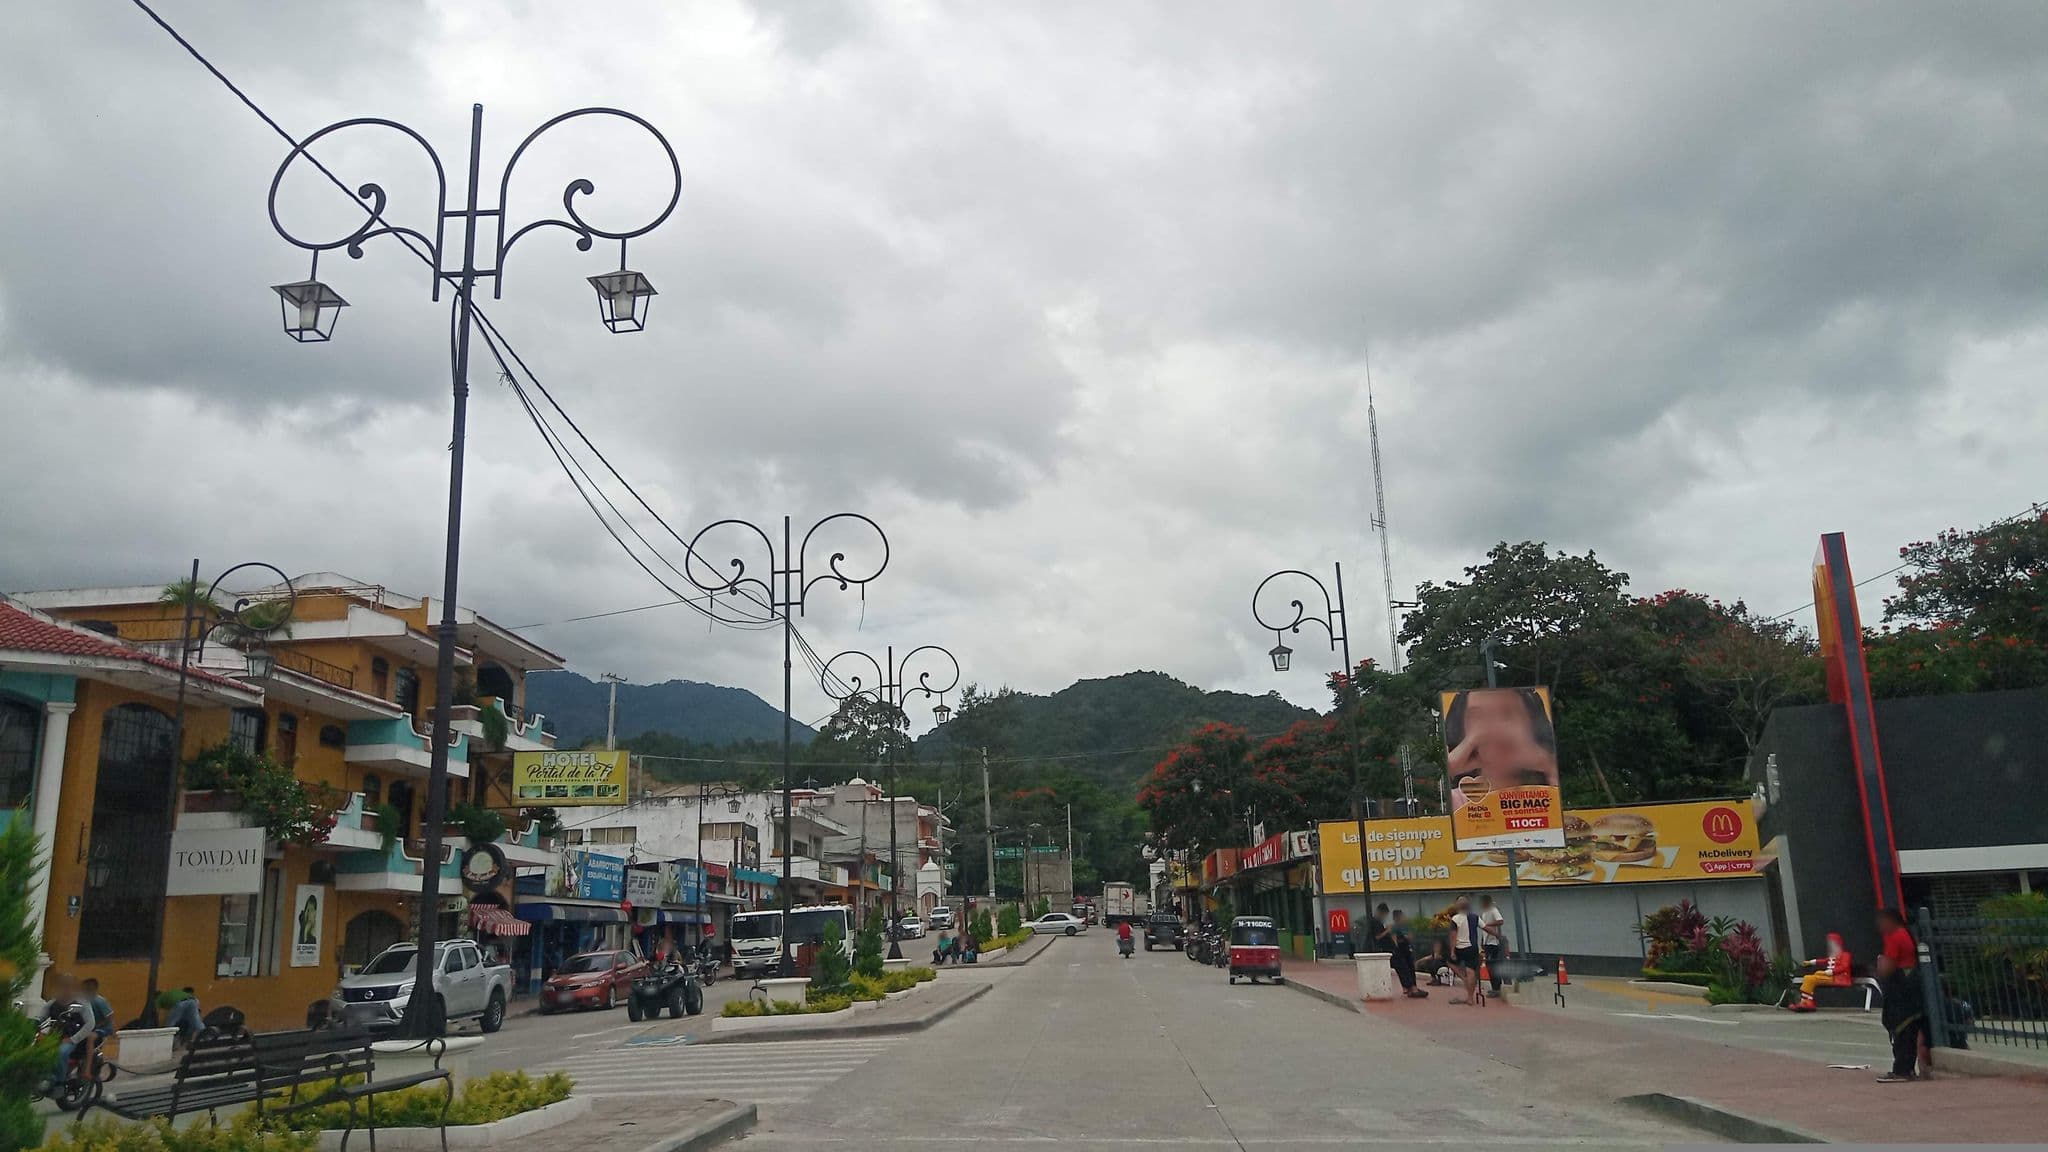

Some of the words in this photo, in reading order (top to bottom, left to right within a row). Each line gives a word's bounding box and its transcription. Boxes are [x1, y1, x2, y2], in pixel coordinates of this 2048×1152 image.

[543, 753, 597, 767] HOTEL
[527, 764, 564, 779] Portal
[567, 766, 581, 778] de
[585, 766, 595, 778] la
[1501, 800, 1523, 809] BIG
[1523, 798, 1550, 808] MAC
[1513, 807, 1548, 815] sonrisas
[1510, 820, 1521, 828] 11
[1521, 818, 1544, 828] OCT.
[1367, 830, 1384, 842] de
[1386, 828, 1442, 842] siempre
[176, 849, 256, 867] TOWDAH
[1367, 842, 1424, 866] mejor
[1698, 848, 1753, 858] McDelivery
[1342, 866, 1380, 887] que
[1384, 865, 1449, 880] nunca
